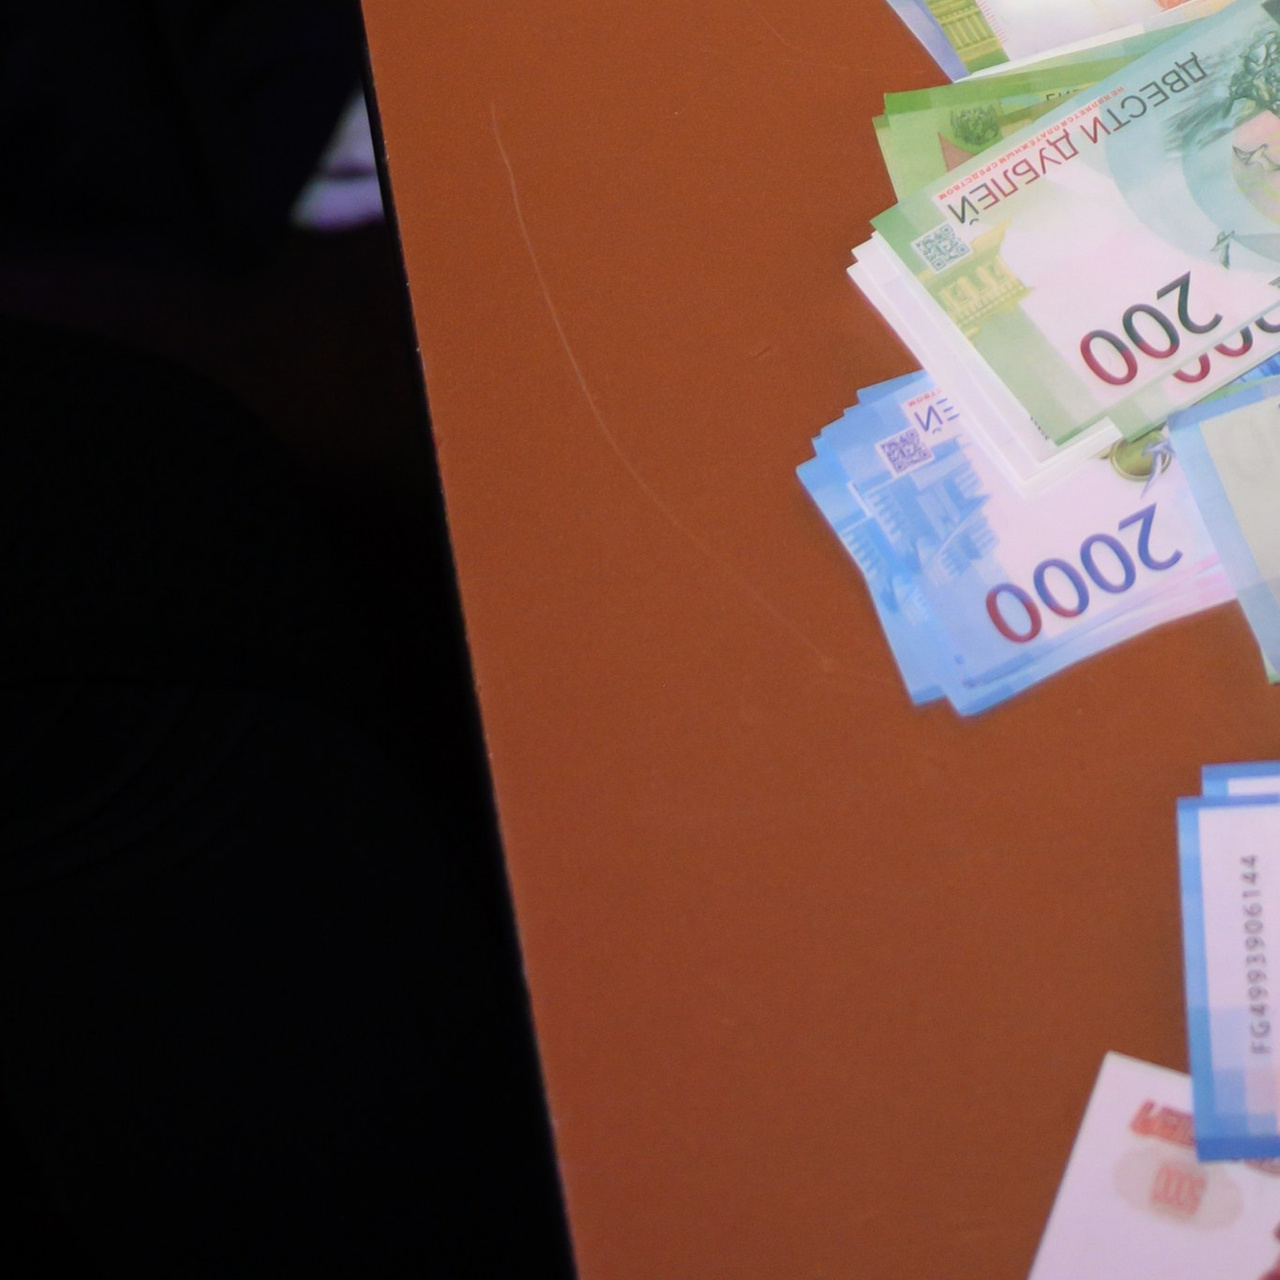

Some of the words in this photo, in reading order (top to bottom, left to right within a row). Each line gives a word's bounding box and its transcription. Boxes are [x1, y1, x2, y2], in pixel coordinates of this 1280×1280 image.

[1080, 51, 1208, 145] ДВЕСТИ
[948, 128, 1080, 226] ДУБЛЕЙ
[1080, 270, 1223, 387] 200
[985, 502, 1184, 645] 2000
